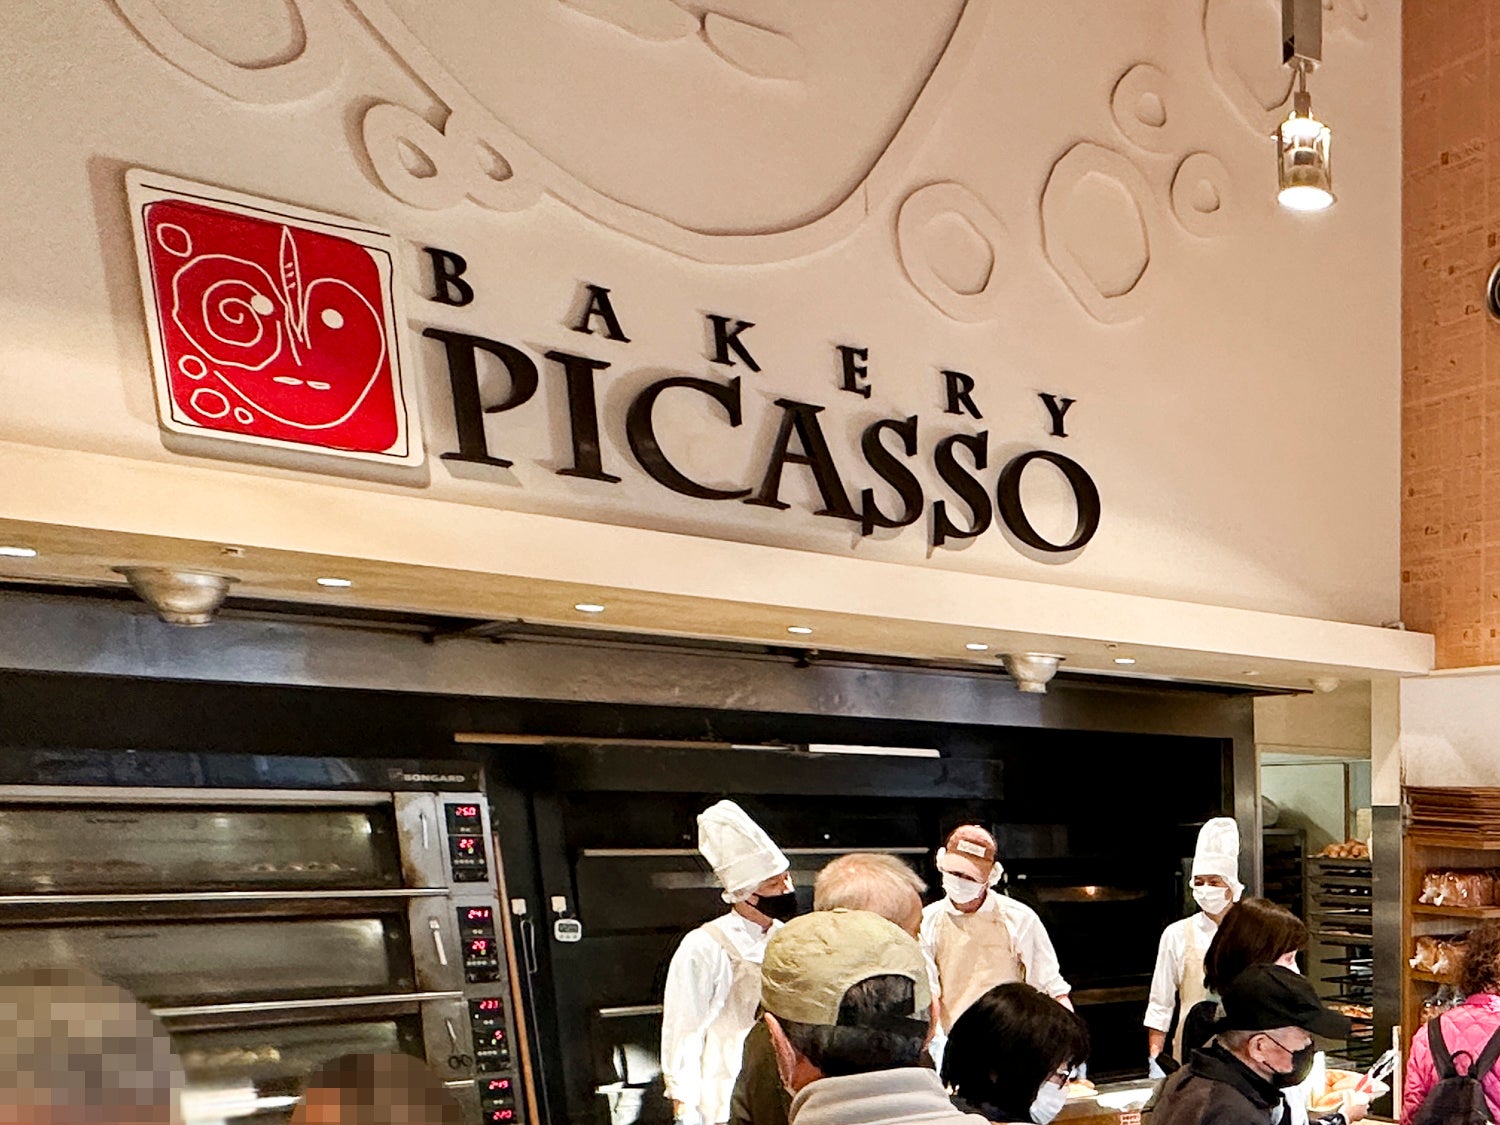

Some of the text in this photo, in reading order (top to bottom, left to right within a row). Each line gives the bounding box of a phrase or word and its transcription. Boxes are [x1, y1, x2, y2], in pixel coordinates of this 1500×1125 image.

[422, 245, 1077, 438] BAKERY
[422, 327, 1101, 553] PICASSO
[403, 774, 465, 782] BONGARD
